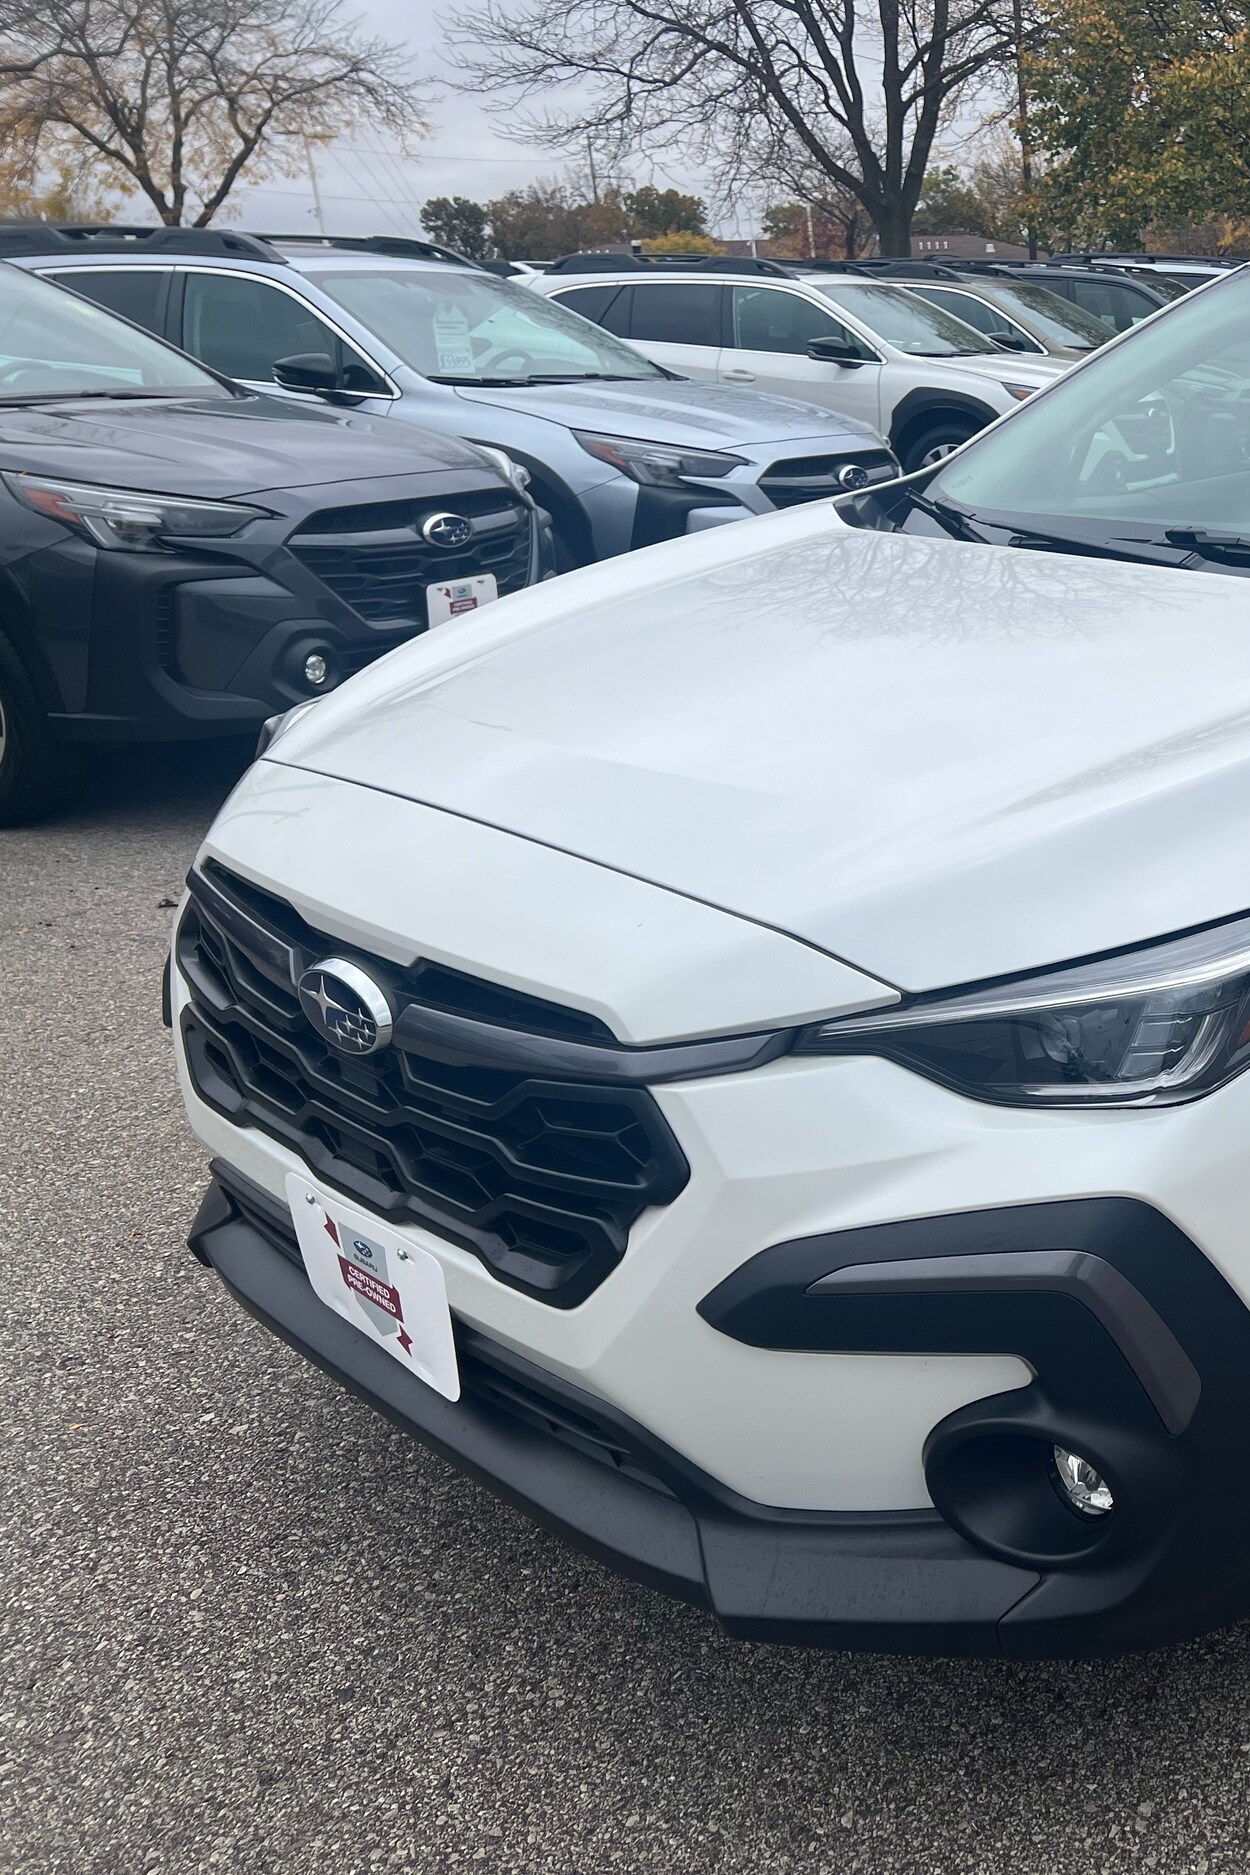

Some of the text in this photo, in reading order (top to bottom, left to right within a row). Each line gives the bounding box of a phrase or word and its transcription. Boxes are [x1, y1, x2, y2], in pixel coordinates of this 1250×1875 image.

[353, 1253, 378, 1272] SUBARU
[347, 1273, 396, 1313] PRE-OWNED
[348, 1265, 390, 1299] CERTIFIED
